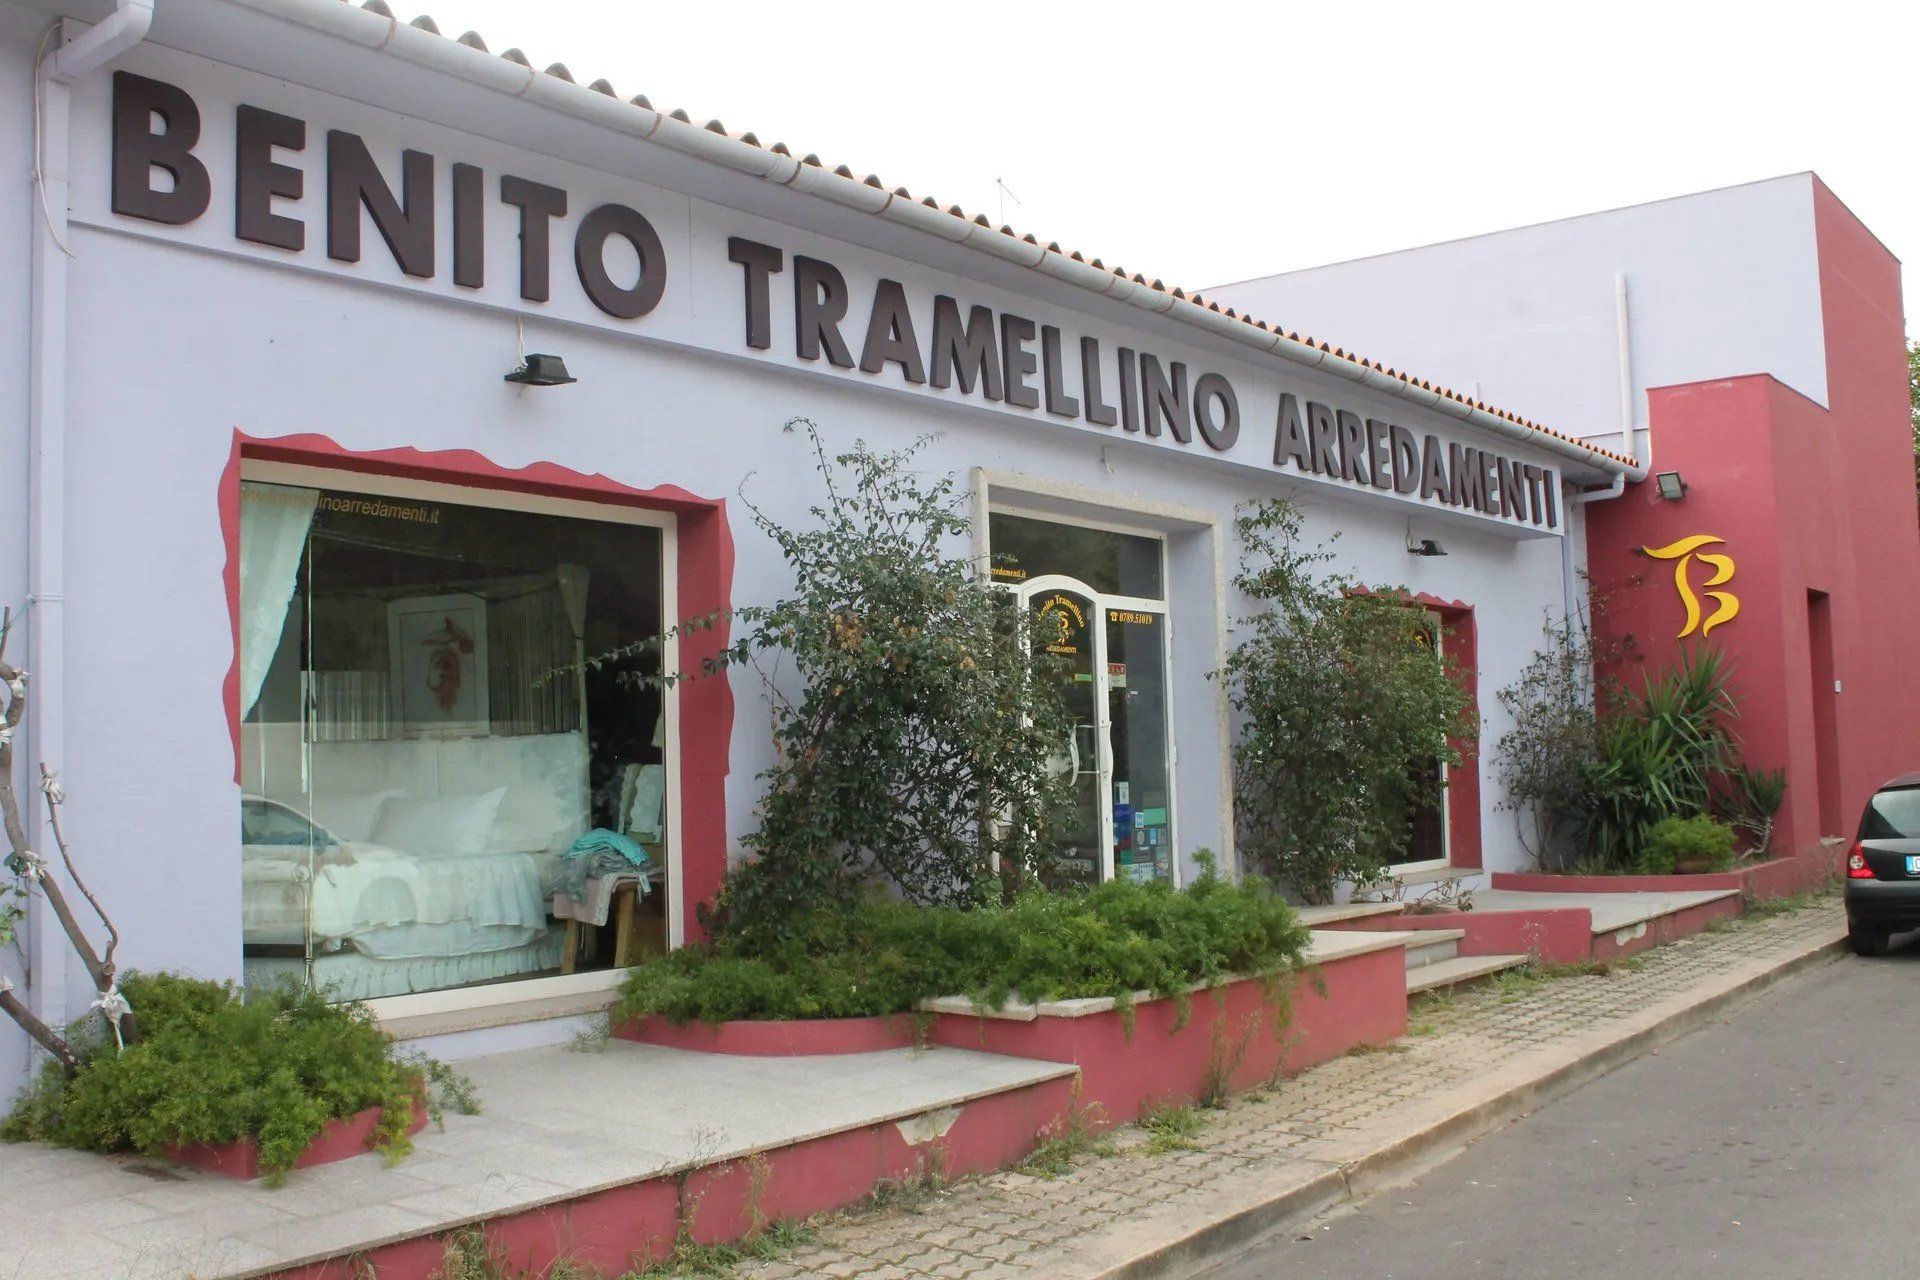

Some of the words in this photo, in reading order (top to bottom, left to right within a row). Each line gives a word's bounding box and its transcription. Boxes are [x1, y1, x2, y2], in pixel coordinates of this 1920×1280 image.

[112, 70, 667, 319] BENITO
[728, 236, 1240, 451] TRAMELLINO
[1273, 392, 1557, 527] ARREDAMENTI
[1054, 594, 1085, 628] Tramellino
